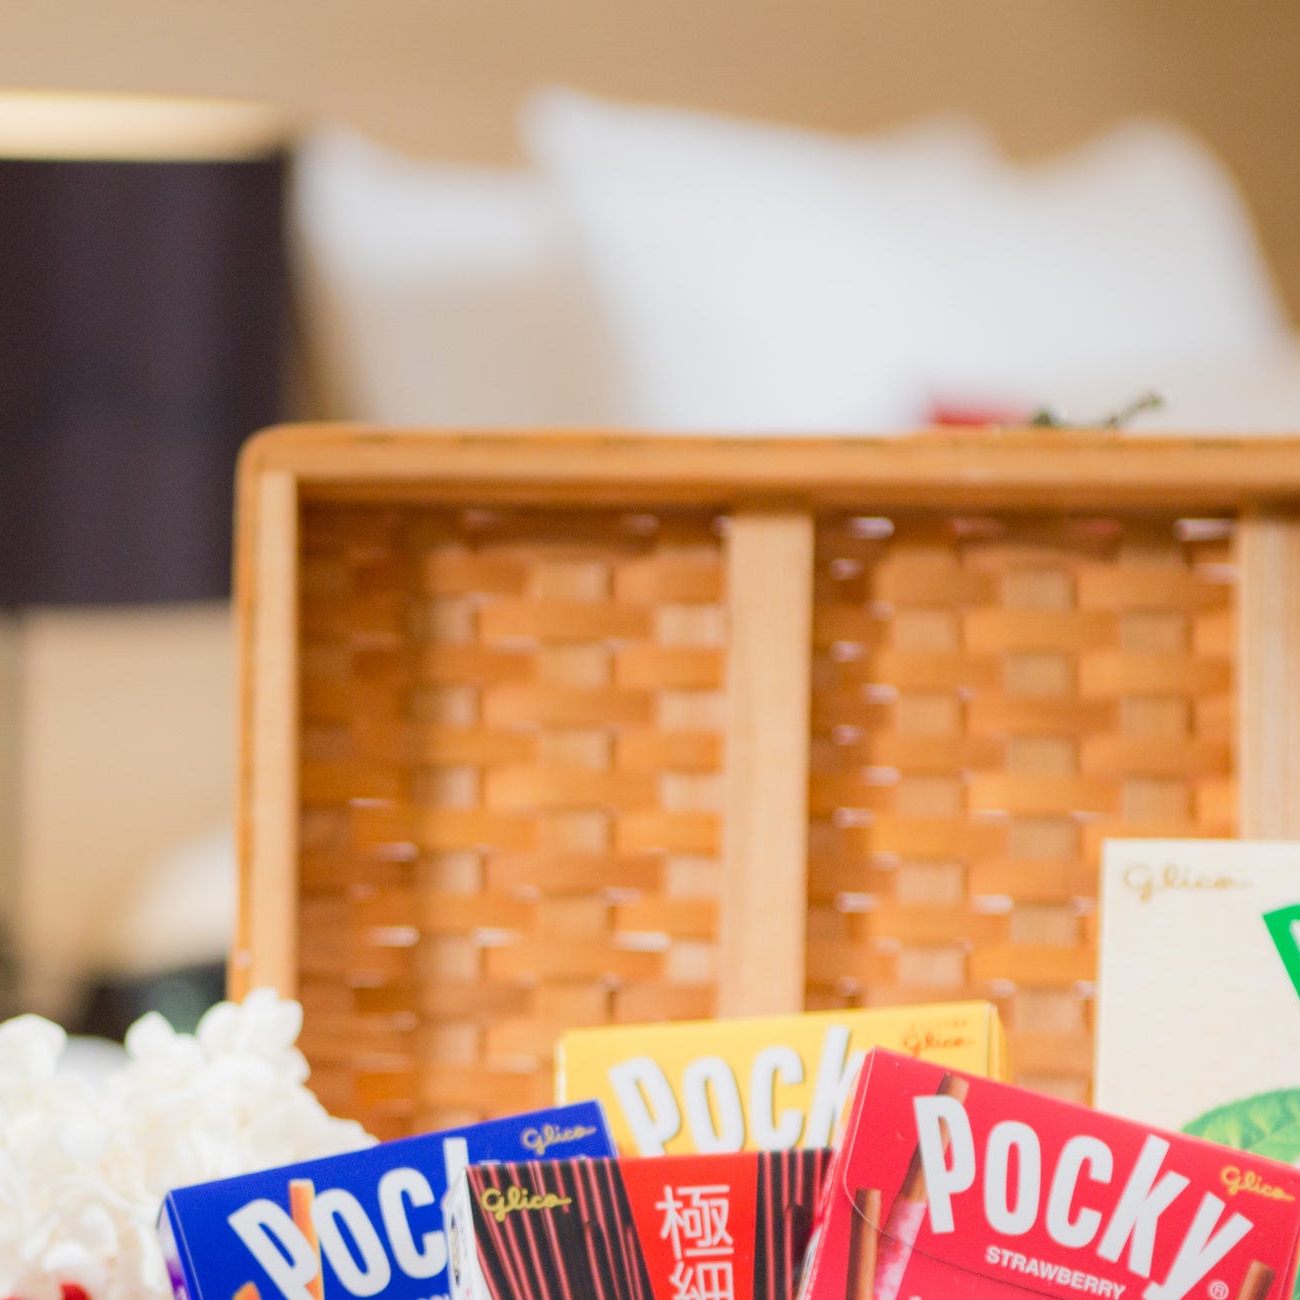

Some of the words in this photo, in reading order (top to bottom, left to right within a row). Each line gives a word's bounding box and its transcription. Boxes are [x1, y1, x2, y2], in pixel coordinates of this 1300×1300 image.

[1122, 863, 1254, 903] Glico
[523, 1124, 597, 1155] Glico
[1221, 1165, 1296, 1202] Glico
[481, 1185, 572, 1222] Glico
[985, 1246, 1126, 1300] STRAWBERRY
